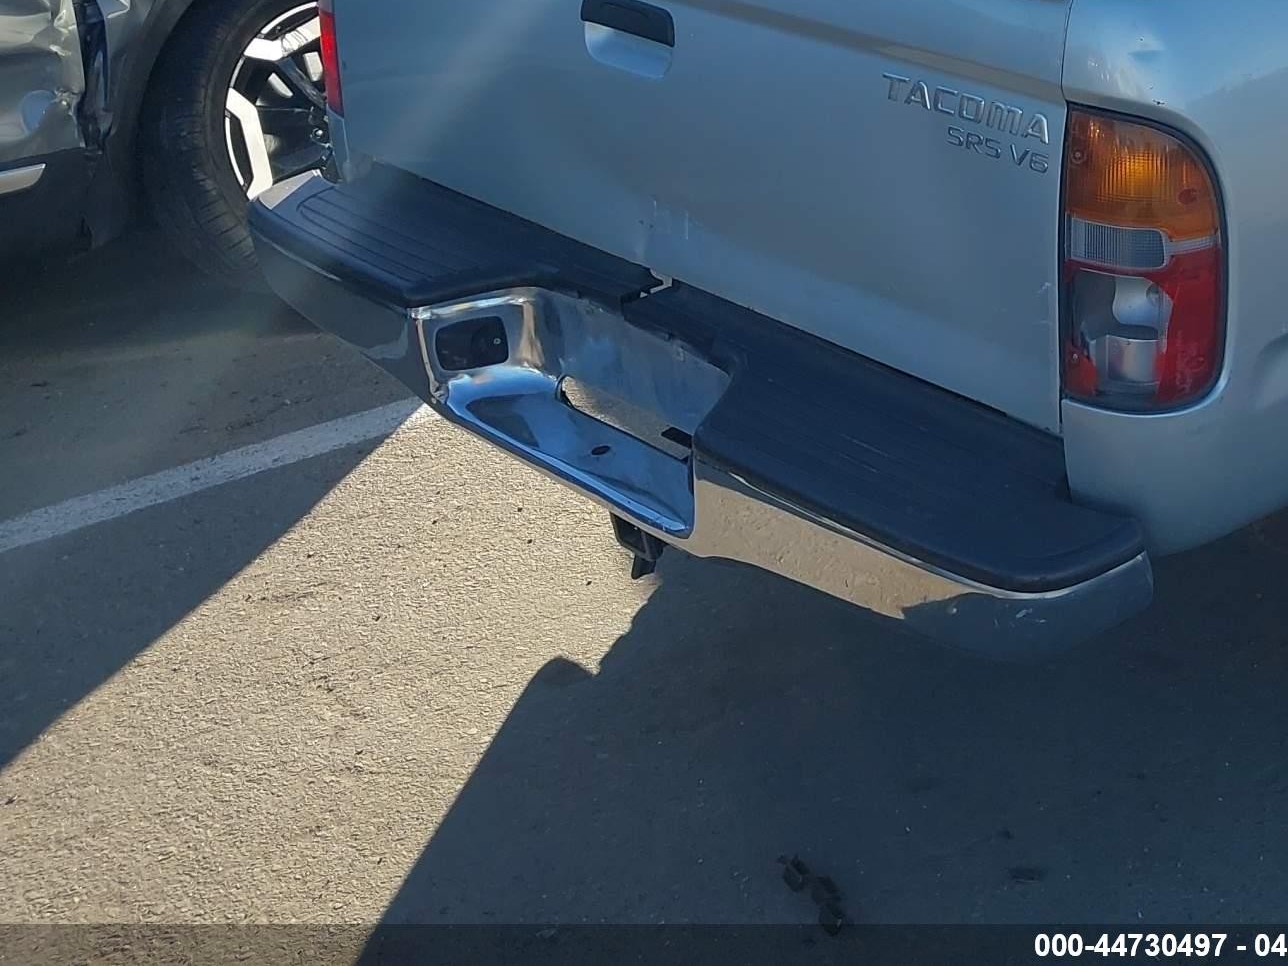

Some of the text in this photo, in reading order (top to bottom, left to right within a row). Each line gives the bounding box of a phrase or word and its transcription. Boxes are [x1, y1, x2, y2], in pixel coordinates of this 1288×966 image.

[882, 72, 1049, 144] TACOMA
[947, 125, 1049, 173] SR5 V6
